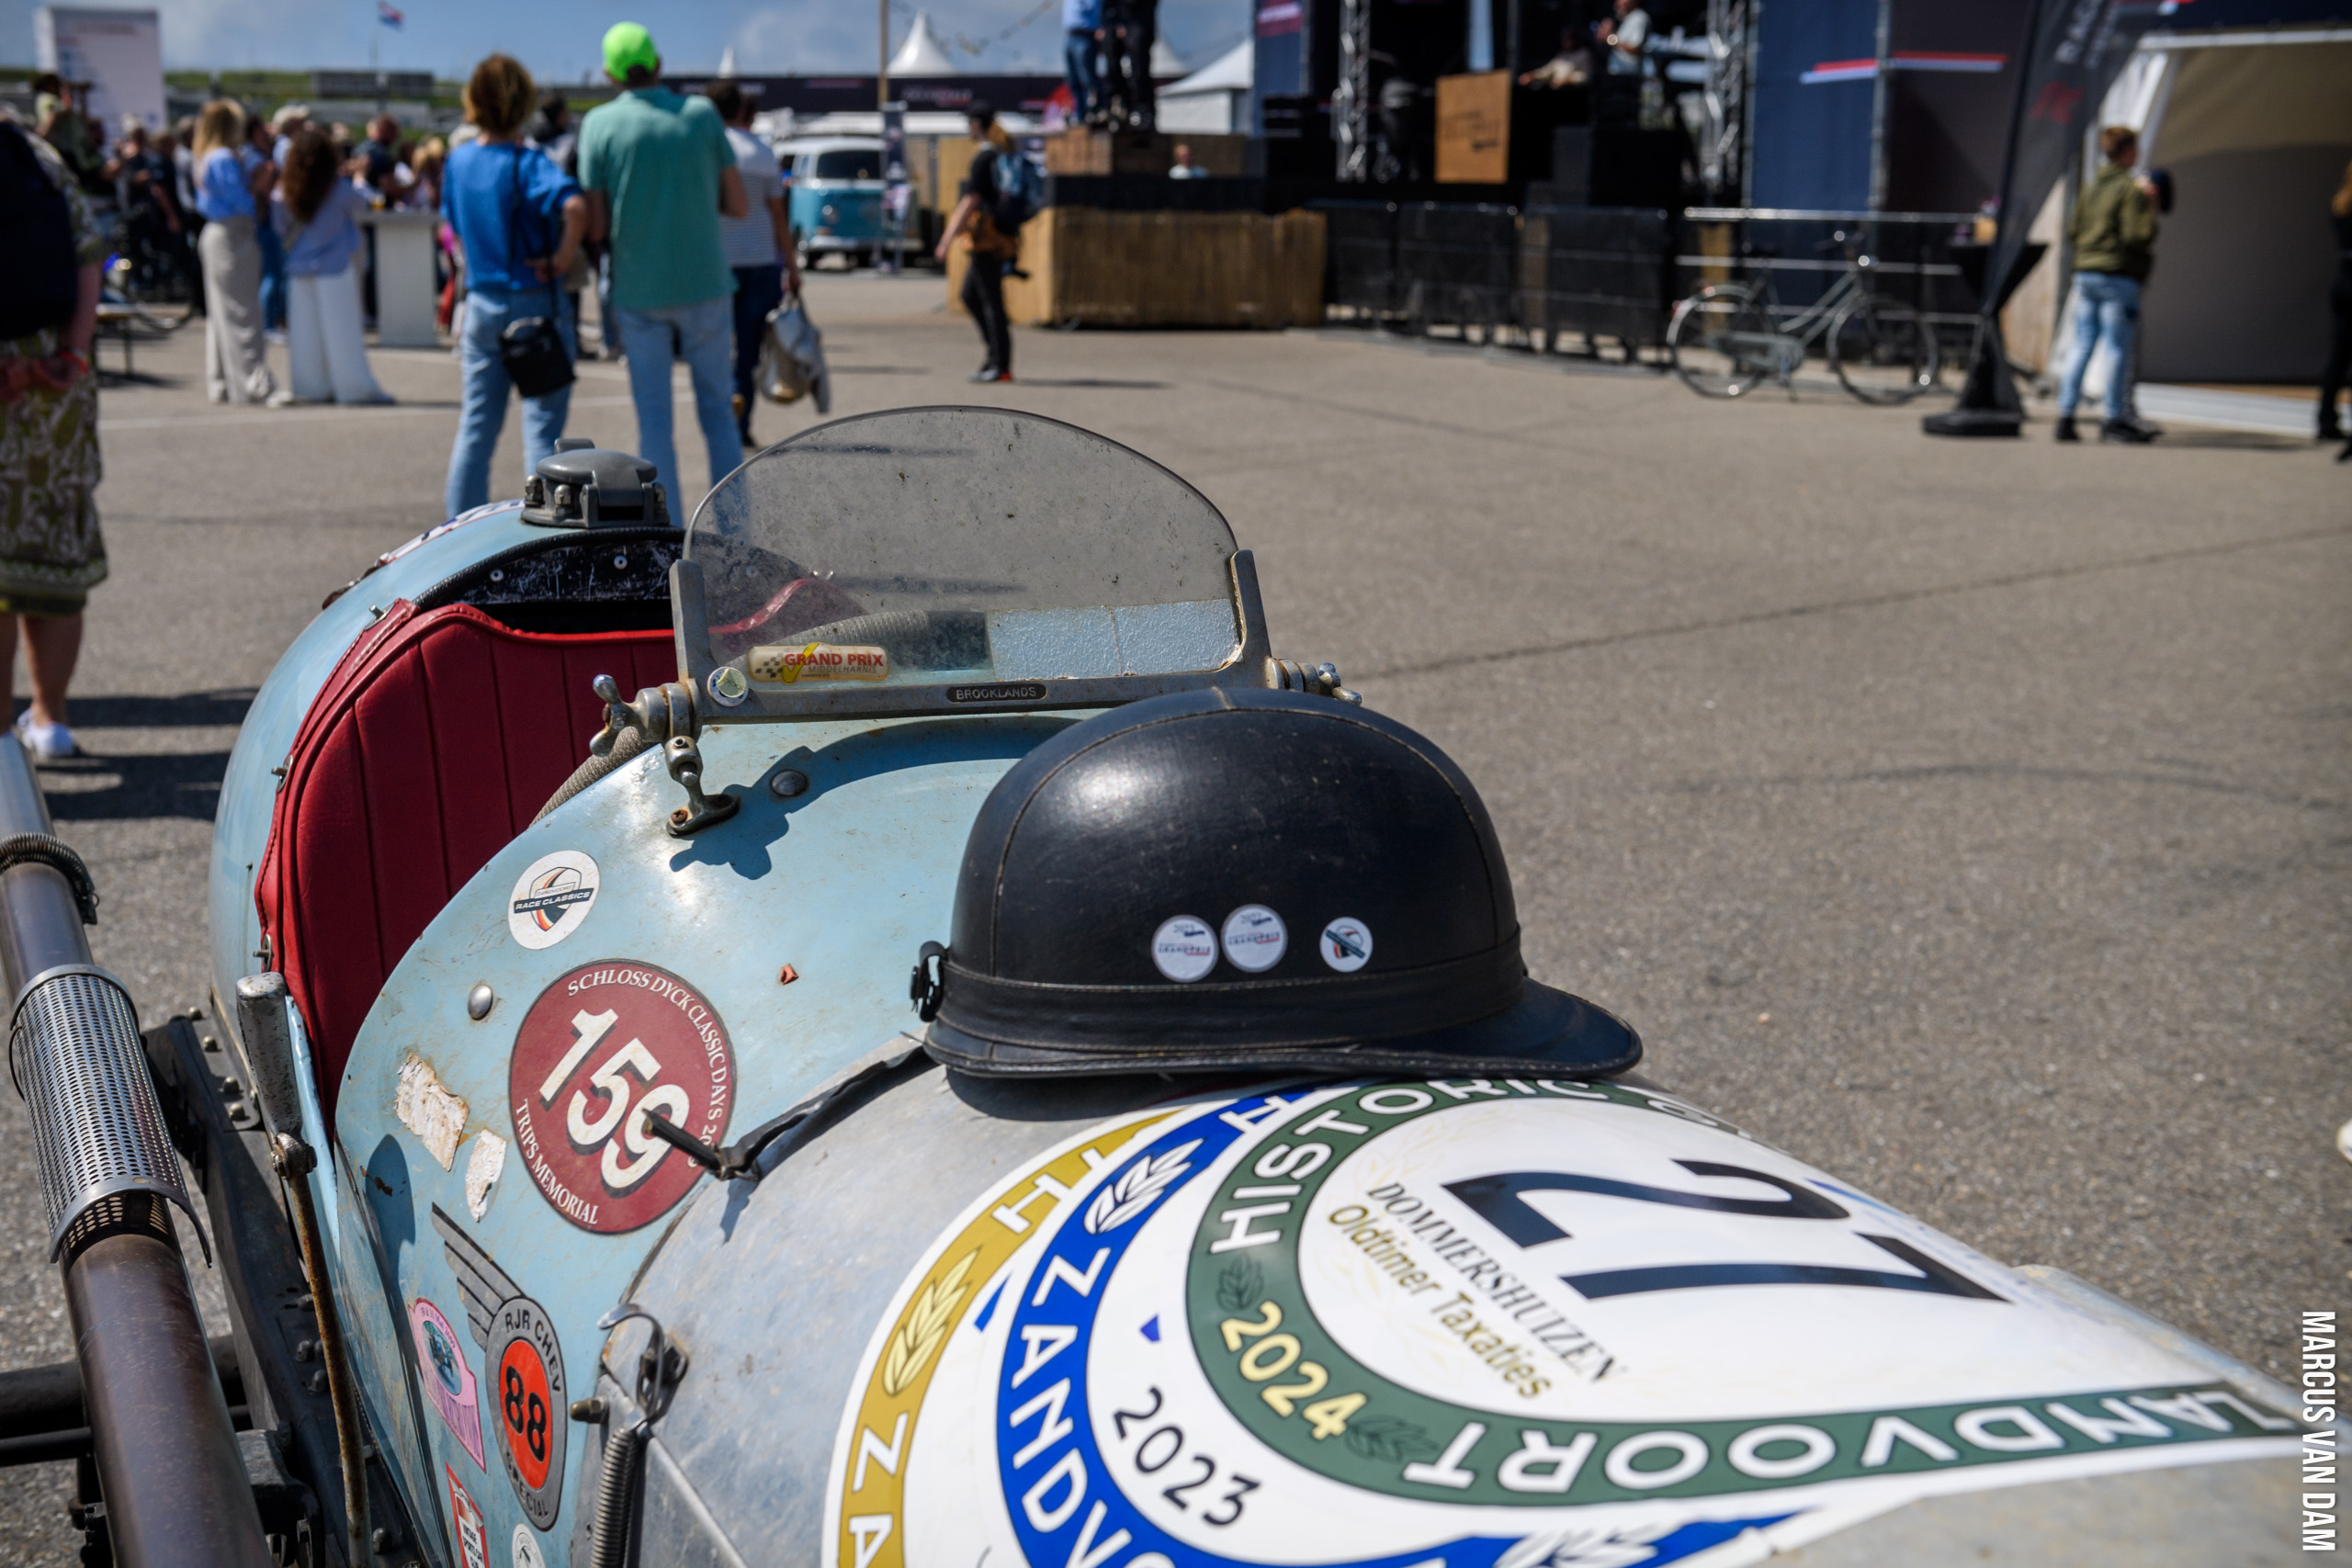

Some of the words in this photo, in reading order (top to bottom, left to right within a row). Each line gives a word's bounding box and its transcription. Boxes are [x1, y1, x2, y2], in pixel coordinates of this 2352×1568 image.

[784, 653, 842, 666] GRAND
[847, 653, 884, 667] PRIX
[808, 665, 877, 674] MIDDELHARNIS
[956, 686, 1037, 700] BROOKLANDS
[514, 900, 541, 910] RACE
[541, 891, 591, 906] CLASSICS
[538, 1008, 691, 1193] 159
[567, 969, 652, 997] SCHLOSS
[650, 976, 695, 1011] DYCK
[687, 1005, 727, 1069] CLASSIC
[707, 1066, 728, 1122] DAYS
[515, 1098, 540, 1160] TRIPS
[531, 1154, 599, 1225] MEMORIAL
[1209, 1078, 1609, 1255] HISTORIC
[1329, 1204, 1442, 1296] Oldtimer
[1430, 1290, 1552, 1399] Taxaties
[1366, 1181, 1626, 1383] DOMMERSHUIZEN
[504, 1364, 548, 1463] 88
[505, 1309, 530, 1334] RJR
[534, 1320, 562, 1393] CHEV
[1220, 1300, 1368, 1442] 2024
[1113, 1386, 1261, 1527] 2023
[1402, 1390, 2298, 1494] ZANDVOORT
